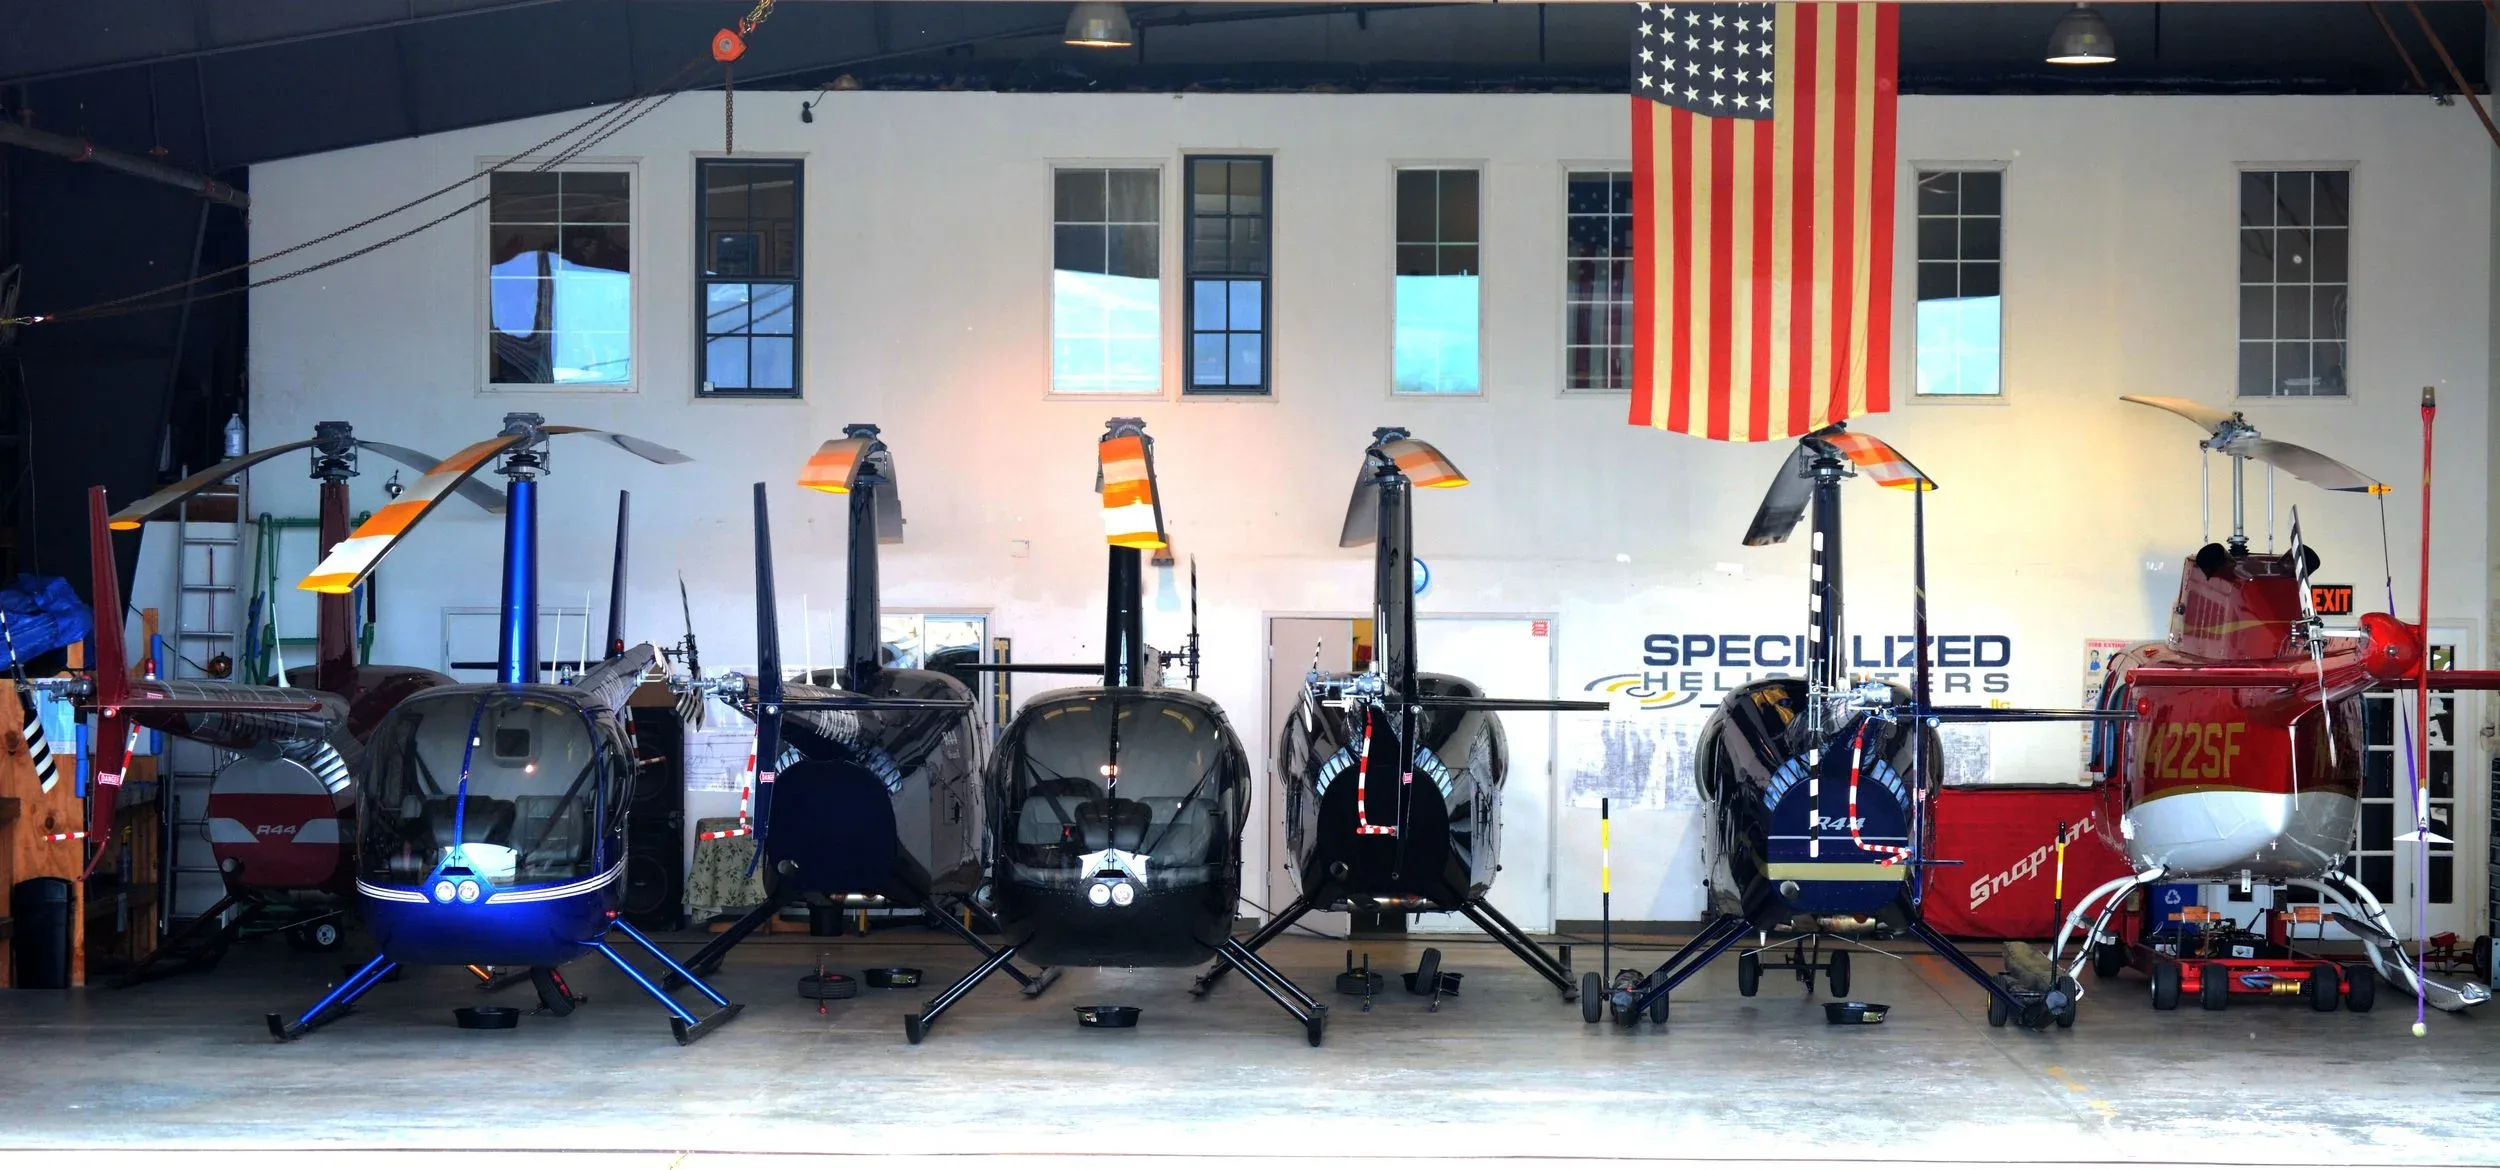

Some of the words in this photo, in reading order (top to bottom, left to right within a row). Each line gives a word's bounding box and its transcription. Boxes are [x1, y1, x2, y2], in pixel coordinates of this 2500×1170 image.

[2312, 588, 2351, 612] EXIT
[1643, 634, 2011, 667] SPECILIZED
[256, 825, 297, 836] R44
[1809, 816, 1866, 831] R44
[1970, 817, 2095, 910] Snap-on
